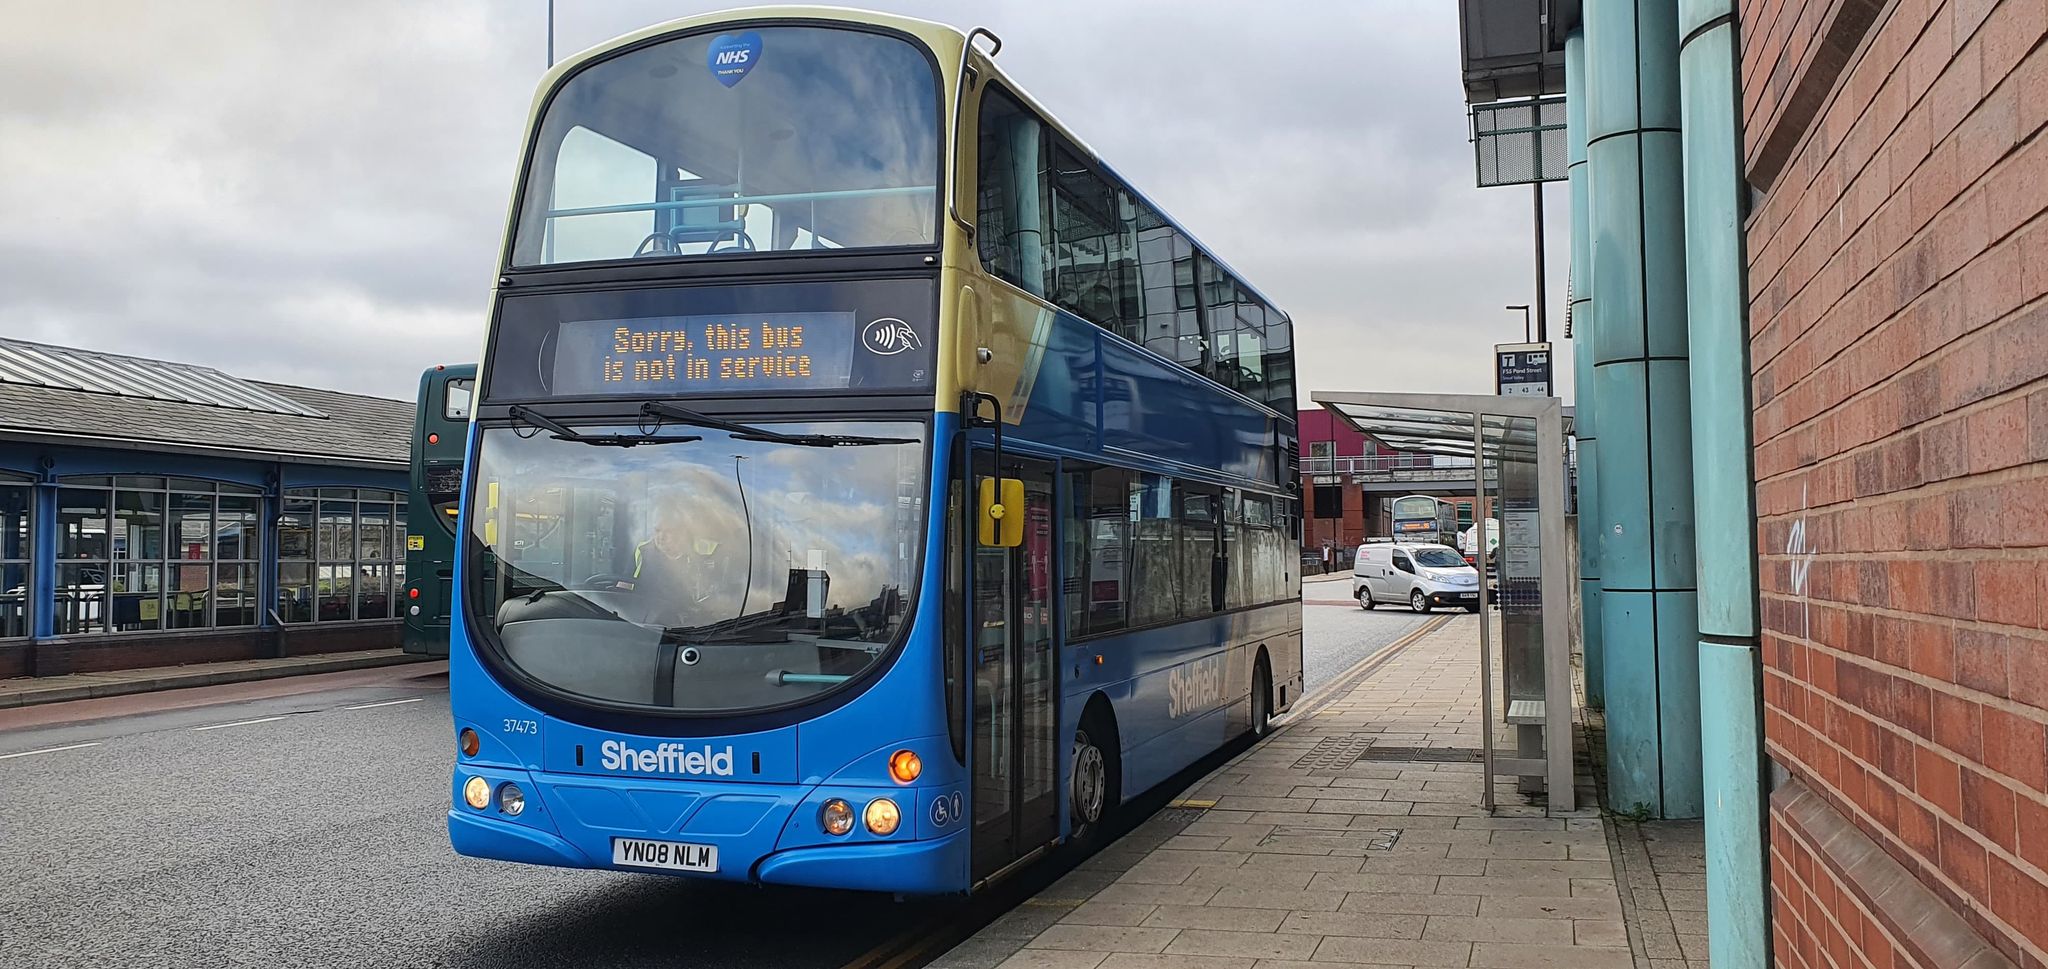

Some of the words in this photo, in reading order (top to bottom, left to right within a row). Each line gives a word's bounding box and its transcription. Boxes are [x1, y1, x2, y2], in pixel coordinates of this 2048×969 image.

[716, 49, 751, 65] NHS
[614, 326, 693, 353] Sorry,
[705, 323, 750, 351] this
[762, 322, 803, 349] bus
[604, 355, 624, 381] is
[634, 353, 676, 380] not
[687, 352, 709, 379] in
[720, 350, 811, 379] service
[1168, 655, 1219, 720] Sheffield
[503, 718, 538, 735] 37473
[601, 740, 734, 776] Sheffield
[622, 840, 669, 864] YN08
[673, 844, 710, 868] NLM
